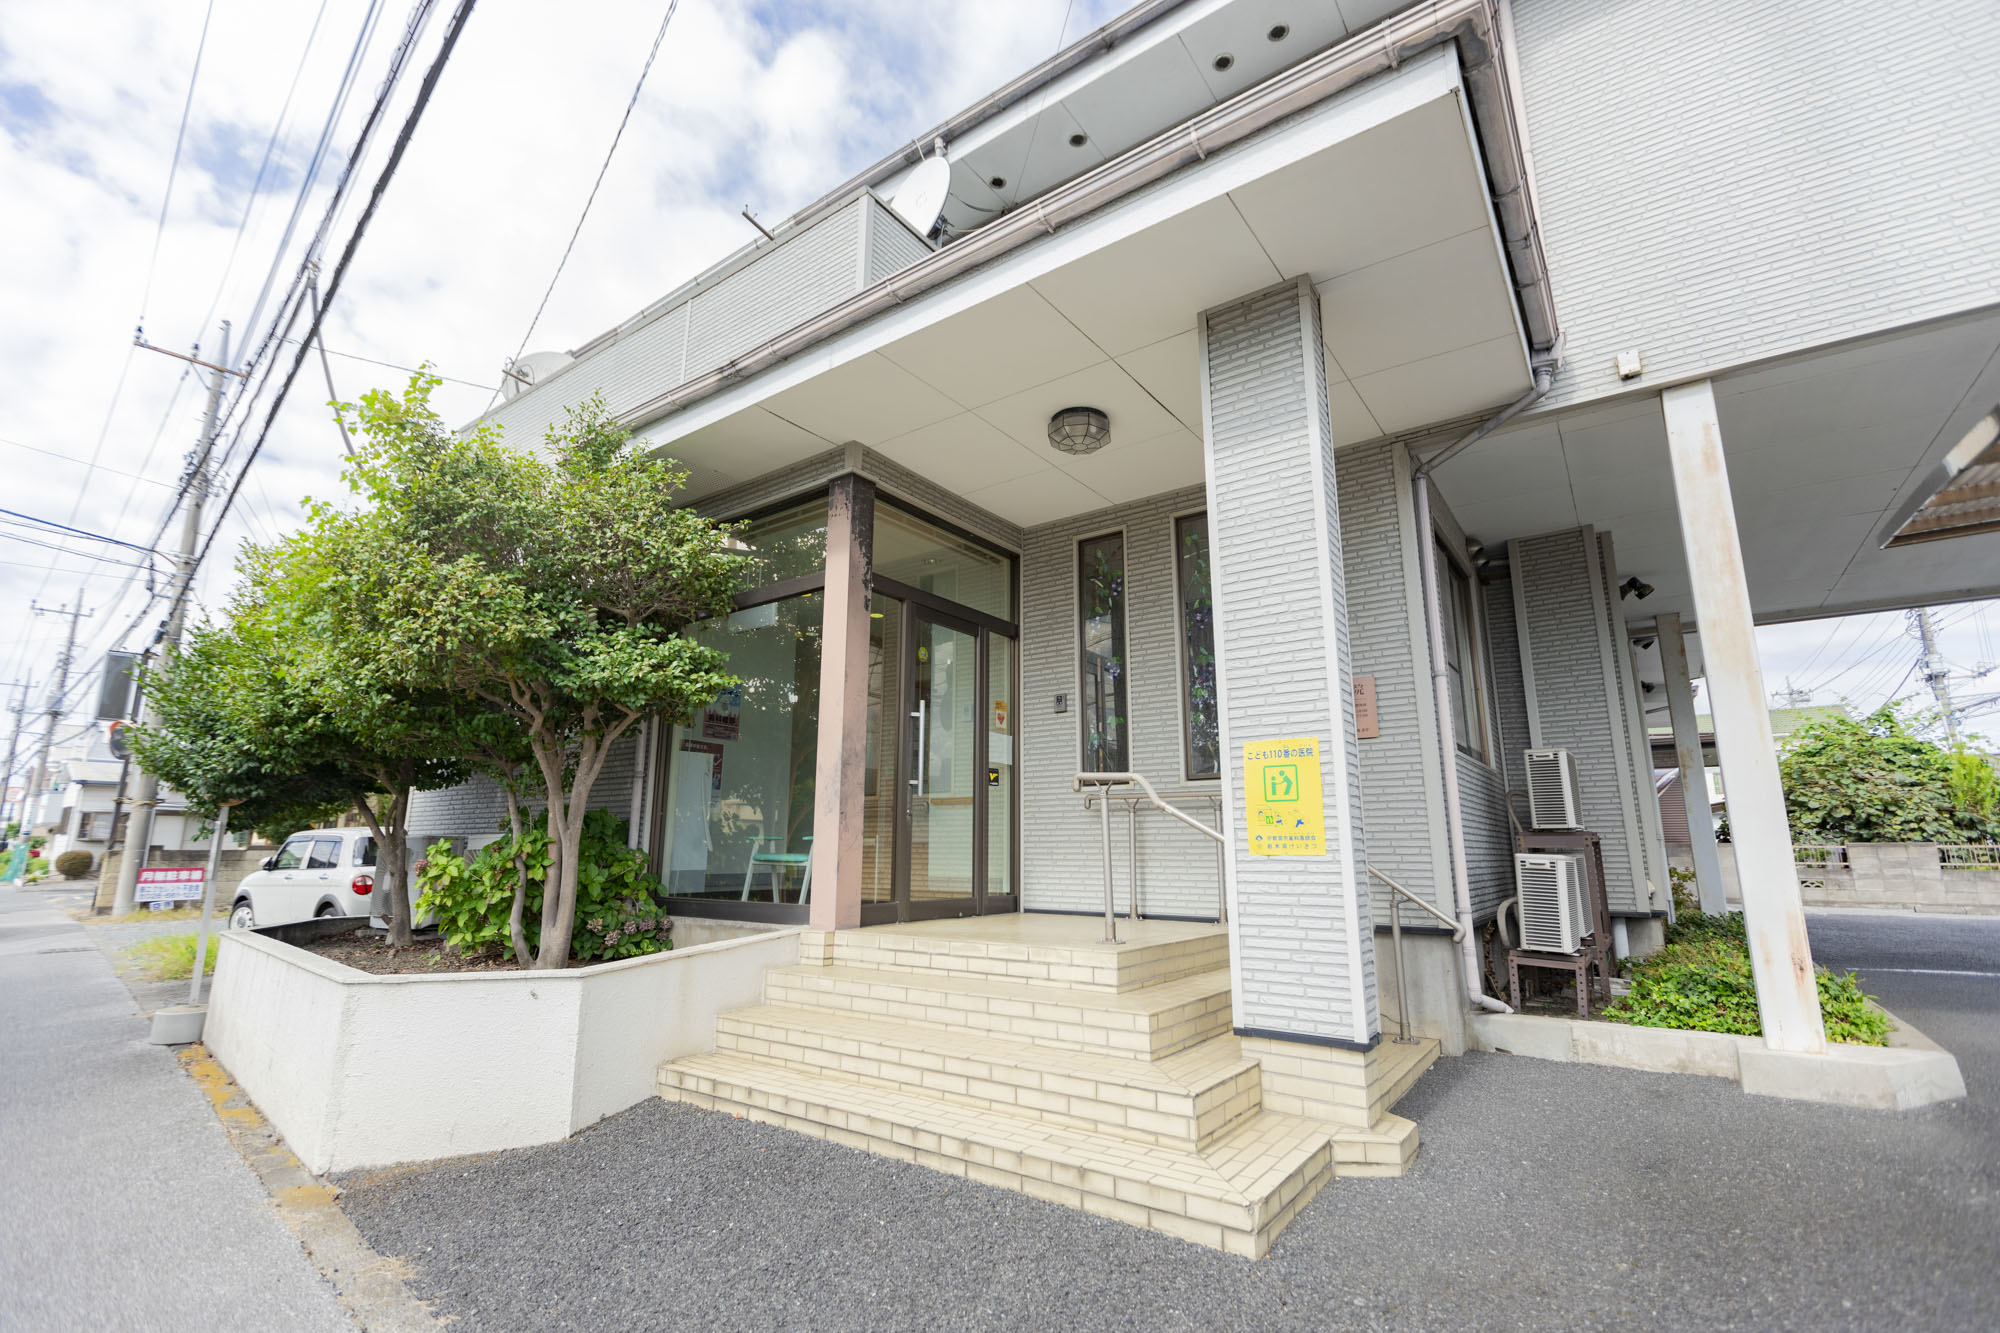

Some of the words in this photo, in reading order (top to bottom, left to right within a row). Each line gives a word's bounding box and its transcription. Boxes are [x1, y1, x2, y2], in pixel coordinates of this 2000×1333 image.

[1247, 747, 1314, 760] こども110番の医院
[140, 870, 203, 881] 月極駐車場
